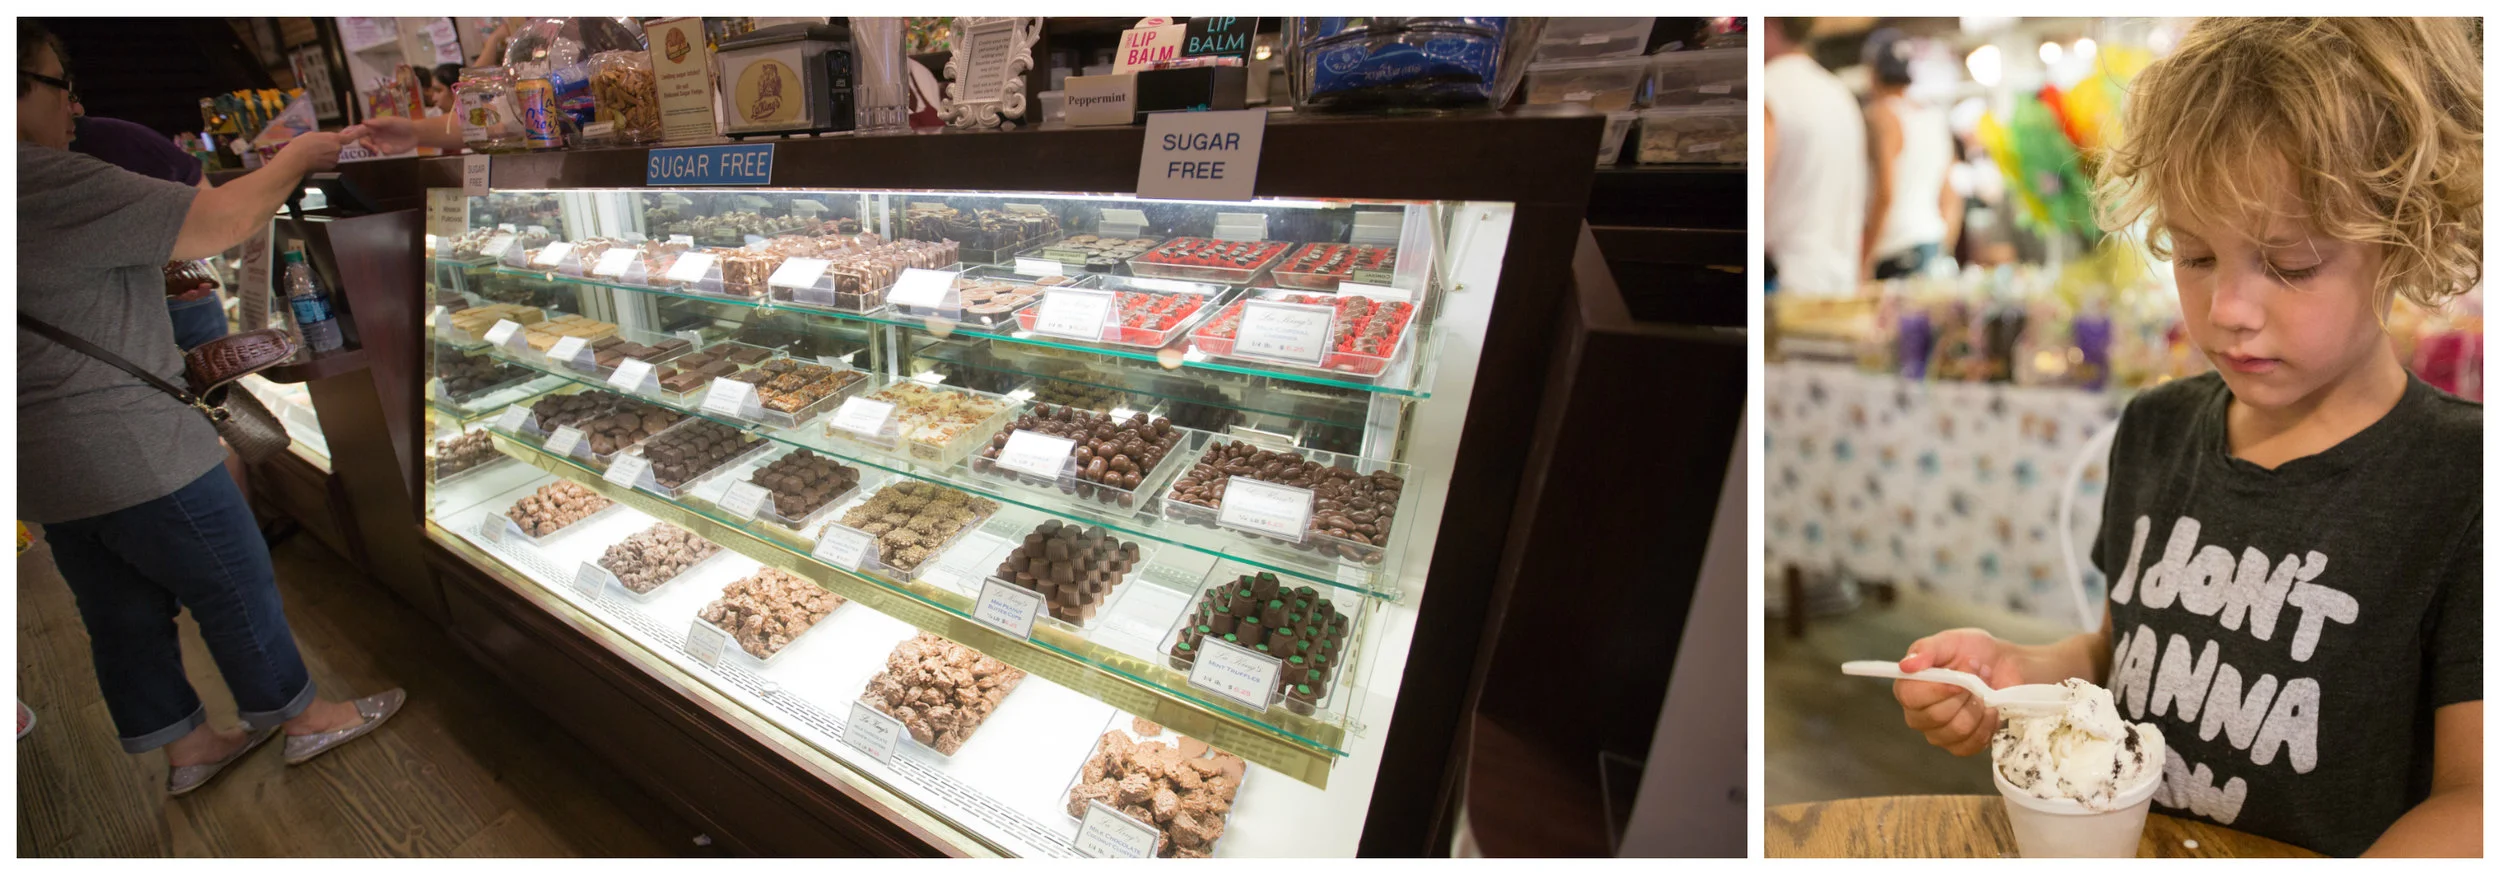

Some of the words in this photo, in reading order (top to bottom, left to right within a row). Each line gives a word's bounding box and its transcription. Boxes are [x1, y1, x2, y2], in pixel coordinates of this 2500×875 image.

[1206, 17, 1237, 32] LIP
[1131, 31, 1157, 47] LIP
[1188, 33, 1245, 53] BALM
[1127, 45, 1174, 65] BALM
[537, 88, 553, 115] La
[1068, 92, 1126, 107] Peppermint
[1162, 132, 1241, 151] SUGAR
[467, 164, 485, 174] SUGAR
[650, 153, 709, 179] SUGAR
[720, 151, 768, 177] FREE
[1167, 161, 1226, 180] FREE
[469, 177, 483, 187] FREE
[2110, 515, 2151, 605] I
[1208, 659, 1225, 670] MINT
[1226, 665, 1261, 684] TRUFFLES
[1086, 830, 1112, 848] COCONUT
[1104, 831, 1141, 856] CHOCOLATE
